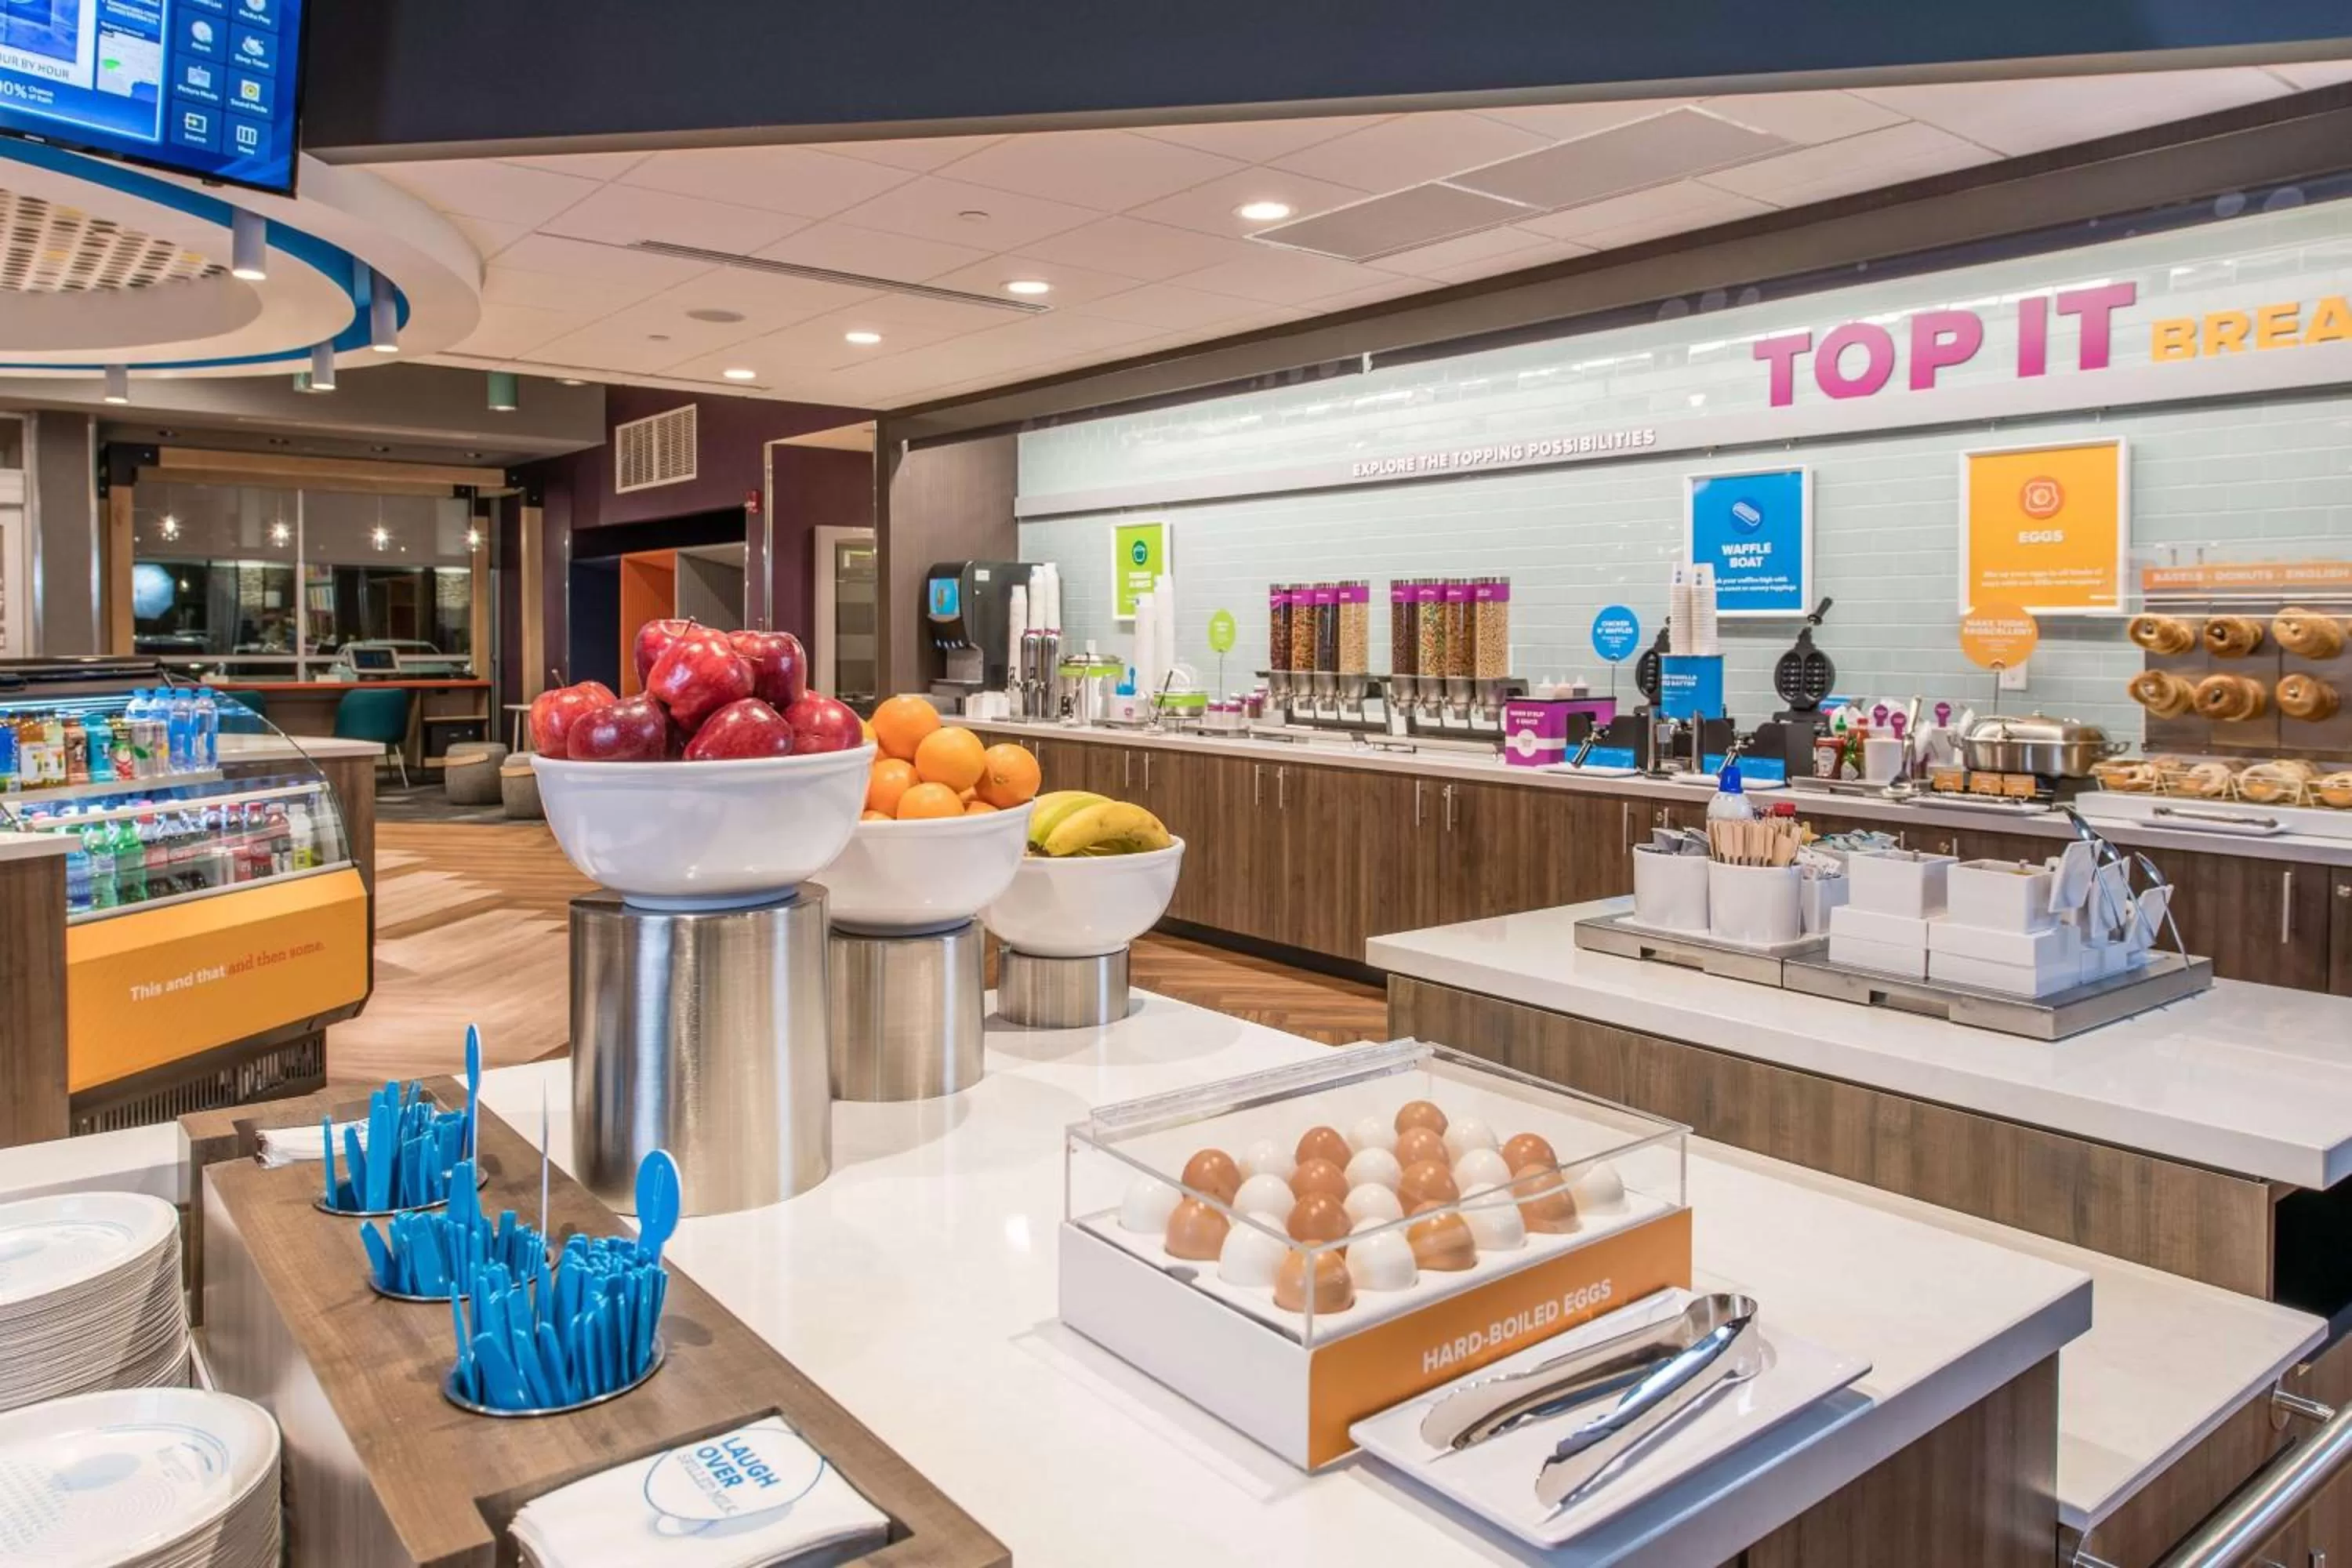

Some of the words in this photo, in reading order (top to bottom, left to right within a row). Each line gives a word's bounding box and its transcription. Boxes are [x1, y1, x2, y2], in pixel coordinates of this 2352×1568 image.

[21, 59, 34, 70] BY
[37, 64, 70, 80] HOUR
[1753, 309, 1984, 408] TOP
[2016, 281, 2137, 378] IT
[2151, 294, 2352, 364] BREA
[1352, 454, 1417, 478] EXPLORE
[1421, 452, 1450, 470] THE
[1454, 444, 1524, 467] TOPPING
[1529, 428, 1657, 459] POSSIBILITIES
[1721, 542, 1773, 556] WAFFLE
[2018, 529, 2065, 544] EGGS
[1729, 557, 1764, 568] BOAT
[129, 985, 162, 1001] This
[165, 972, 194, 993] and
[196, 964, 226, 983] that
[227, 954, 253, 975] and
[256, 949, 287, 967] then
[289, 941, 326, 960] some.
[1423, 1300, 1559, 1374] HARD-BOILED
[1563, 1278, 1612, 1316] EGGS
[696, 1445, 745, 1489] OVER
[720, 1436, 782, 1490] LAUGH
